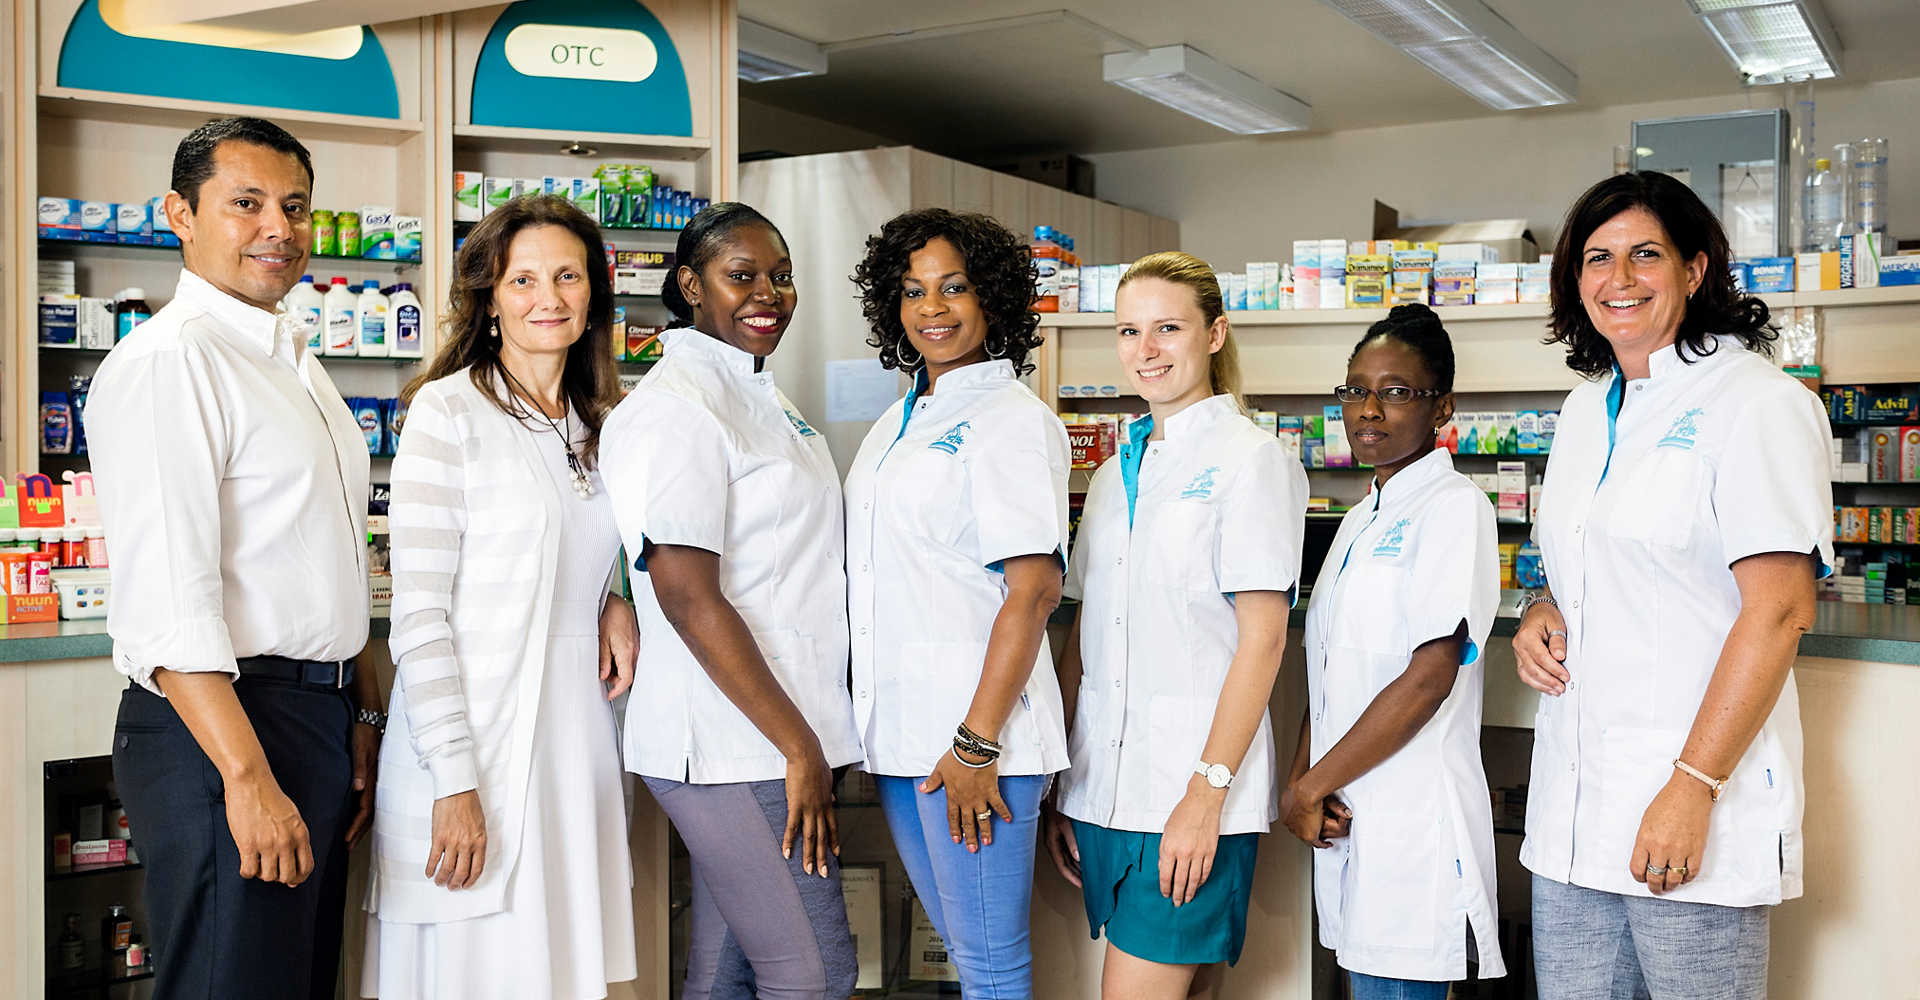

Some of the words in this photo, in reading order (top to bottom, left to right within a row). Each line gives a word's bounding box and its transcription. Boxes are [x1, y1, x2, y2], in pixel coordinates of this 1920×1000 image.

[551, 44, 605, 66] OTC
[617, 252, 664, 264] EFIRUB
[1844, 391, 1854, 416] Advil
[1873, 398, 1909, 409] Advil
[374, 488, 391, 501] Za
[15, 597, 53, 605] nuun
